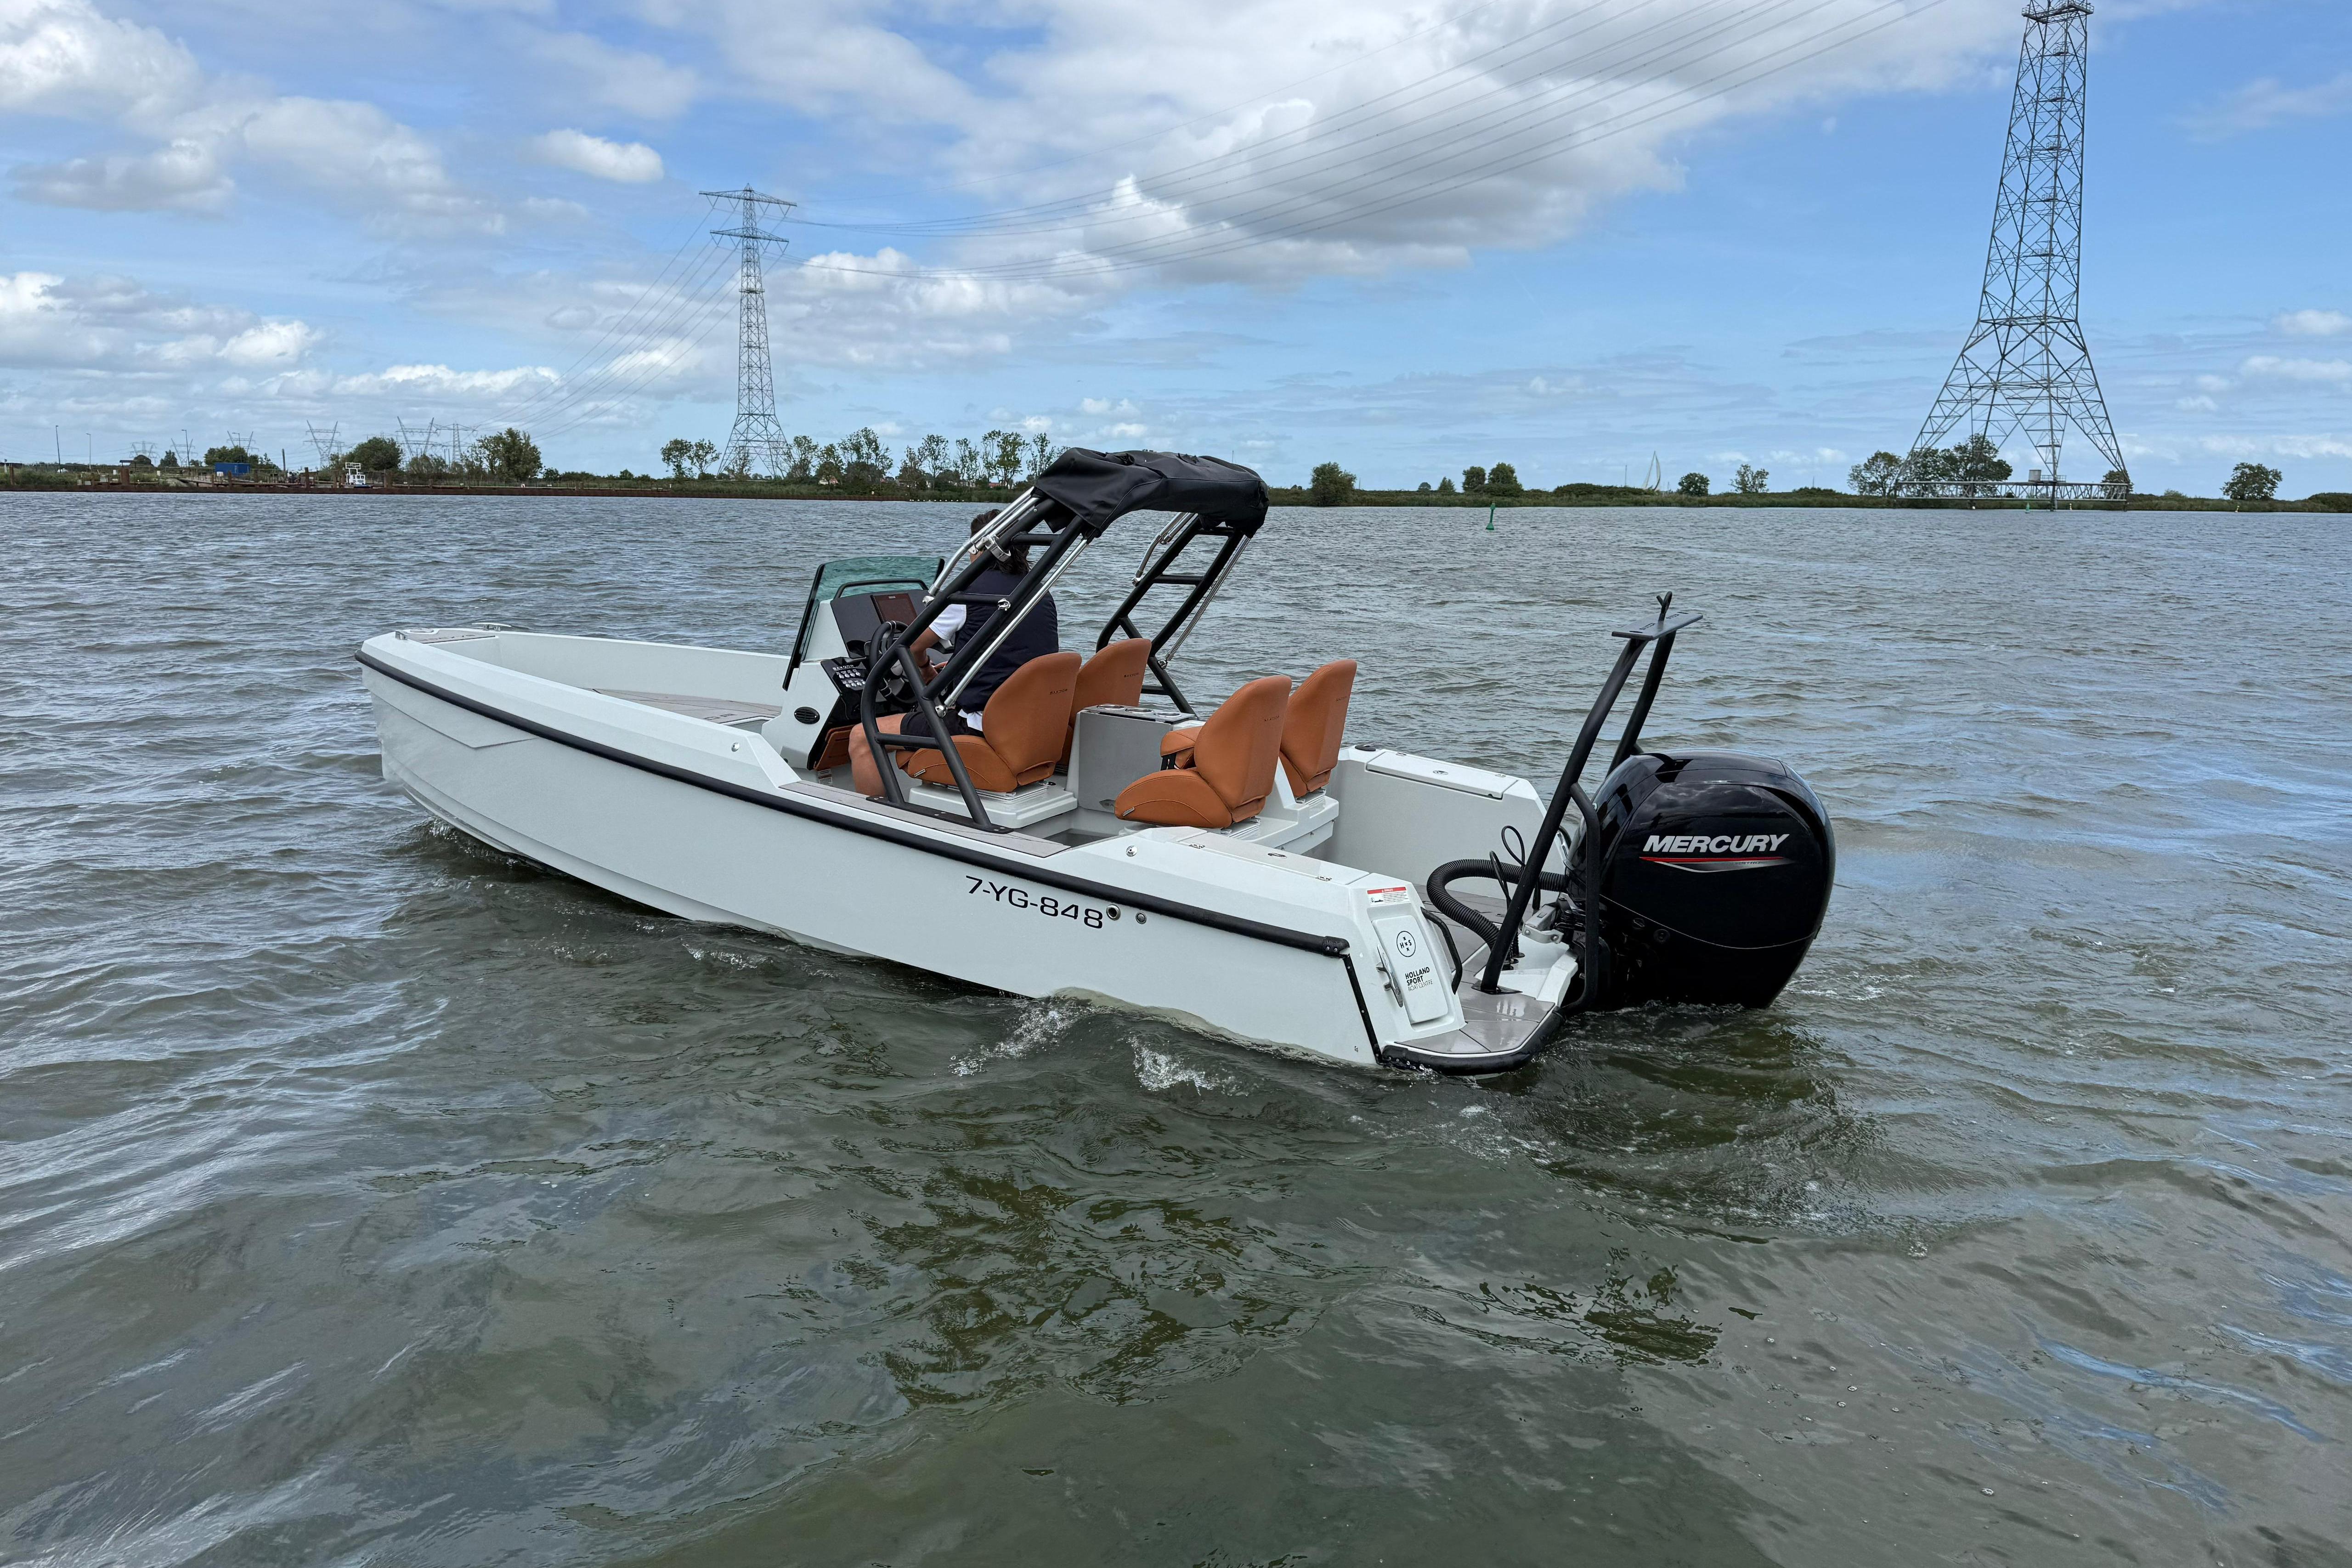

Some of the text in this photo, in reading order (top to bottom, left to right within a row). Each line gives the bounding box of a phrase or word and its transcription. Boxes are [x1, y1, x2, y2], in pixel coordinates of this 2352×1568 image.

[1643, 834, 1790, 853] MERCURY
[966, 875, 1103, 929] 7-YG-848
[1405, 967, 1430, 979] HOLLAND
[1407, 975, 1423, 986] SPORT
[1419, 979, 1433, 988] CENTRE
